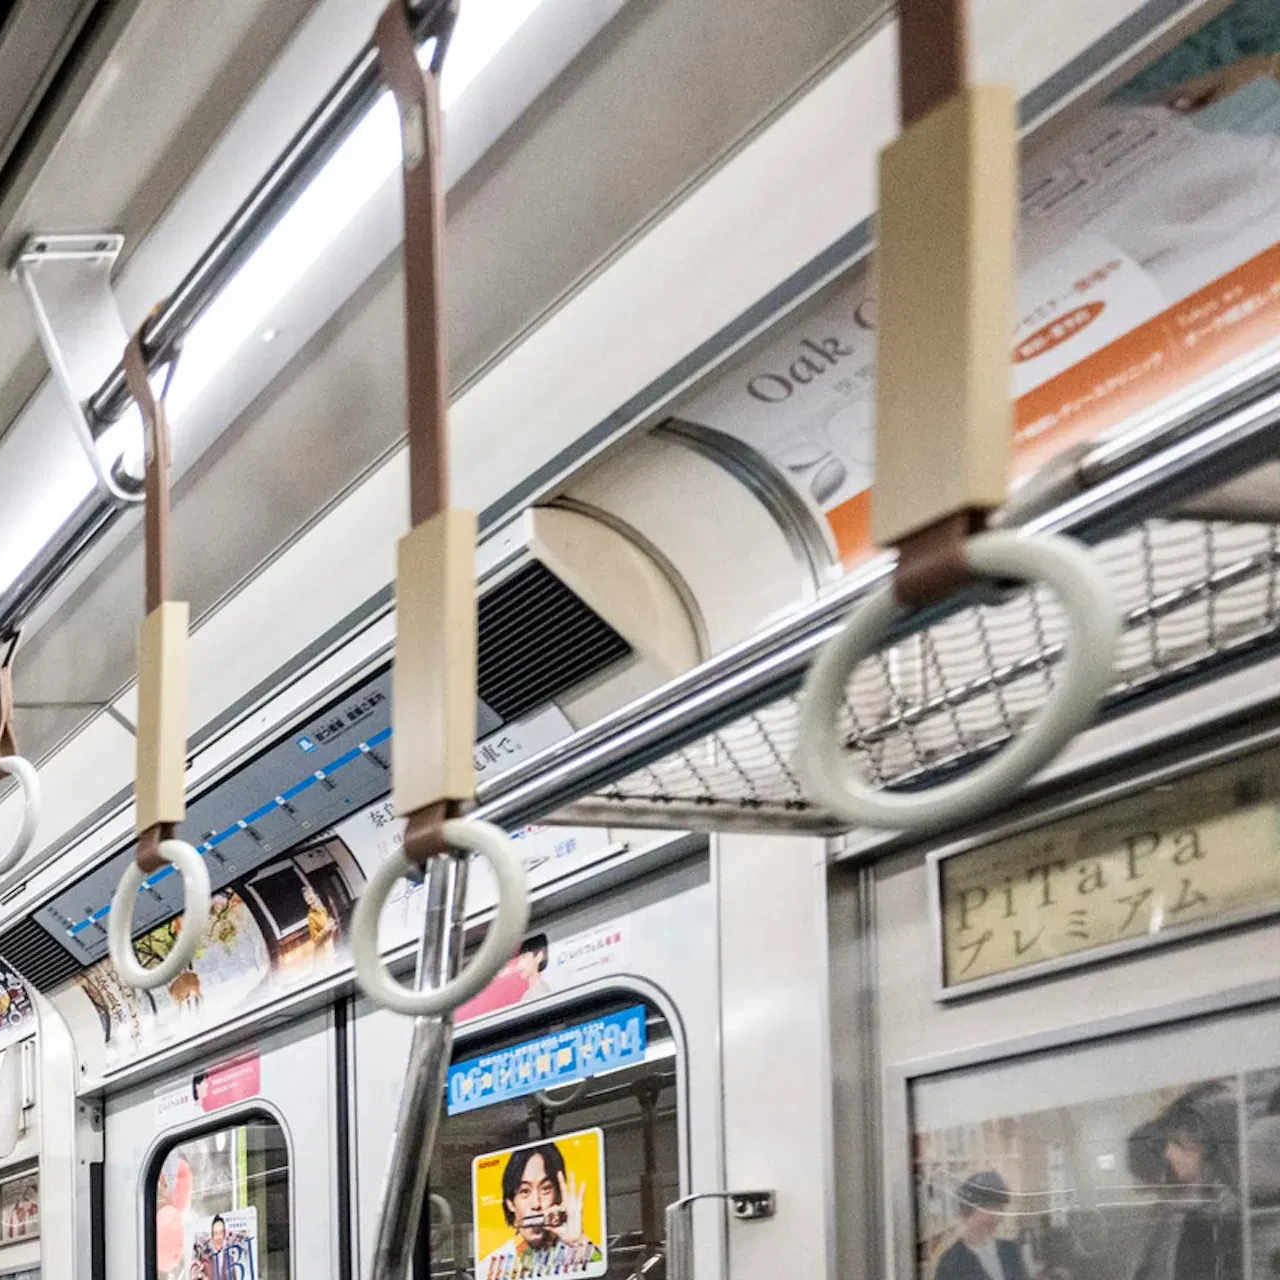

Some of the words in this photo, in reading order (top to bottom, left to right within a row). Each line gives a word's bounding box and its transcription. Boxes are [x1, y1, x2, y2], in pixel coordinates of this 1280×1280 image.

[746, 337, 854, 404] Oak
[956, 878, 1209, 974] プレミアム
[957, 828, 1206, 931] PiTaPa
